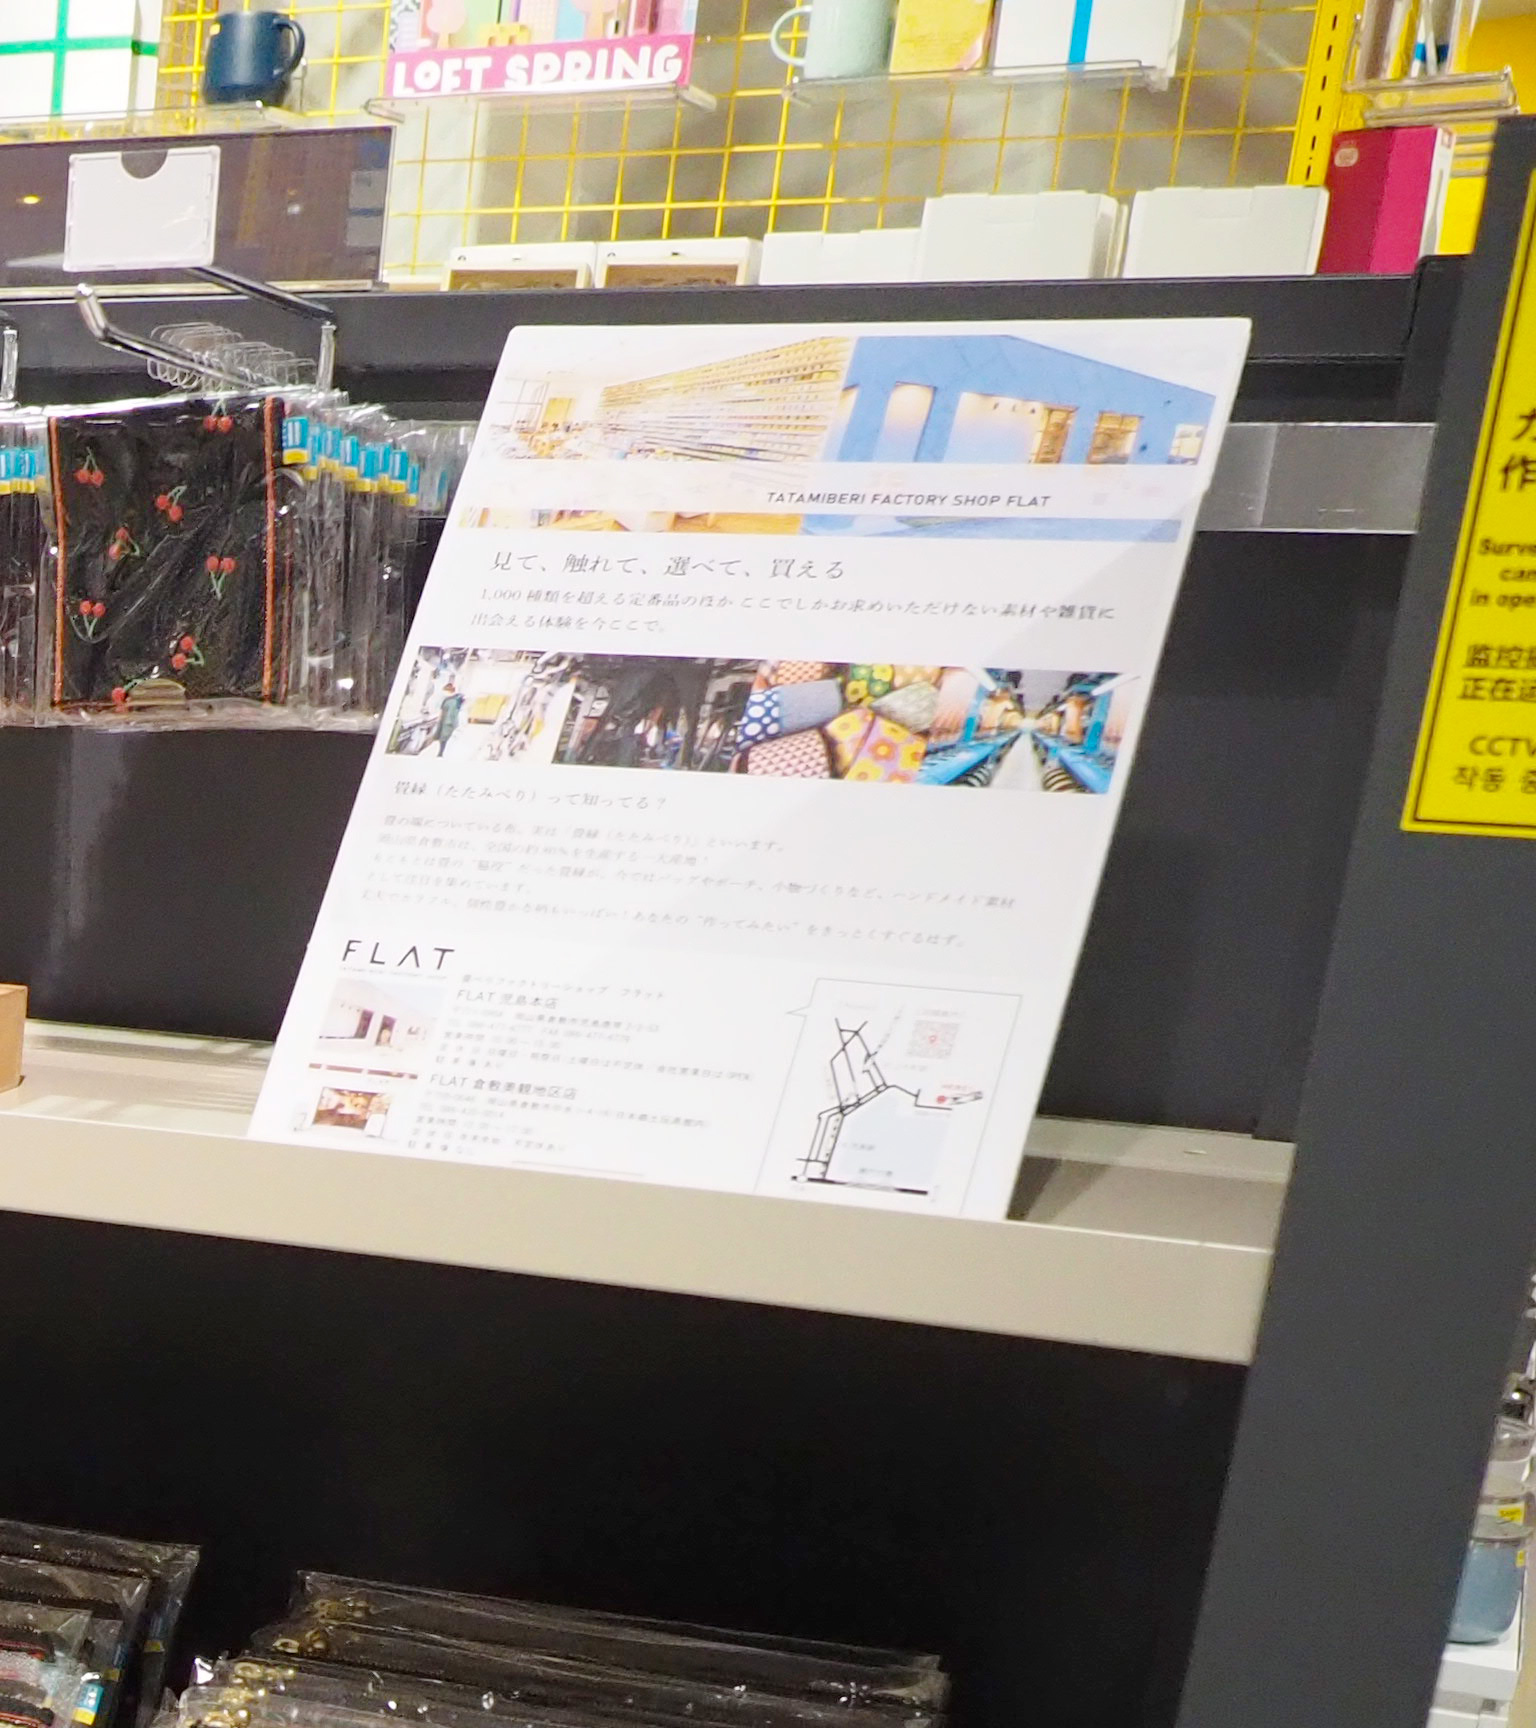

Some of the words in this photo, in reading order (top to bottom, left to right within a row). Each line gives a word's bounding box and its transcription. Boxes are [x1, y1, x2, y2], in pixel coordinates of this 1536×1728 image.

[392, 55, 492, 98] LOFT
[504, 44, 683, 88] SPRING
[766, 491, 866, 505] TATAMIBERI
[871, 493, 948, 506] FACTORY
[952, 494, 1001, 507] SHOP
[1006, 495, 1052, 508] FLAT
